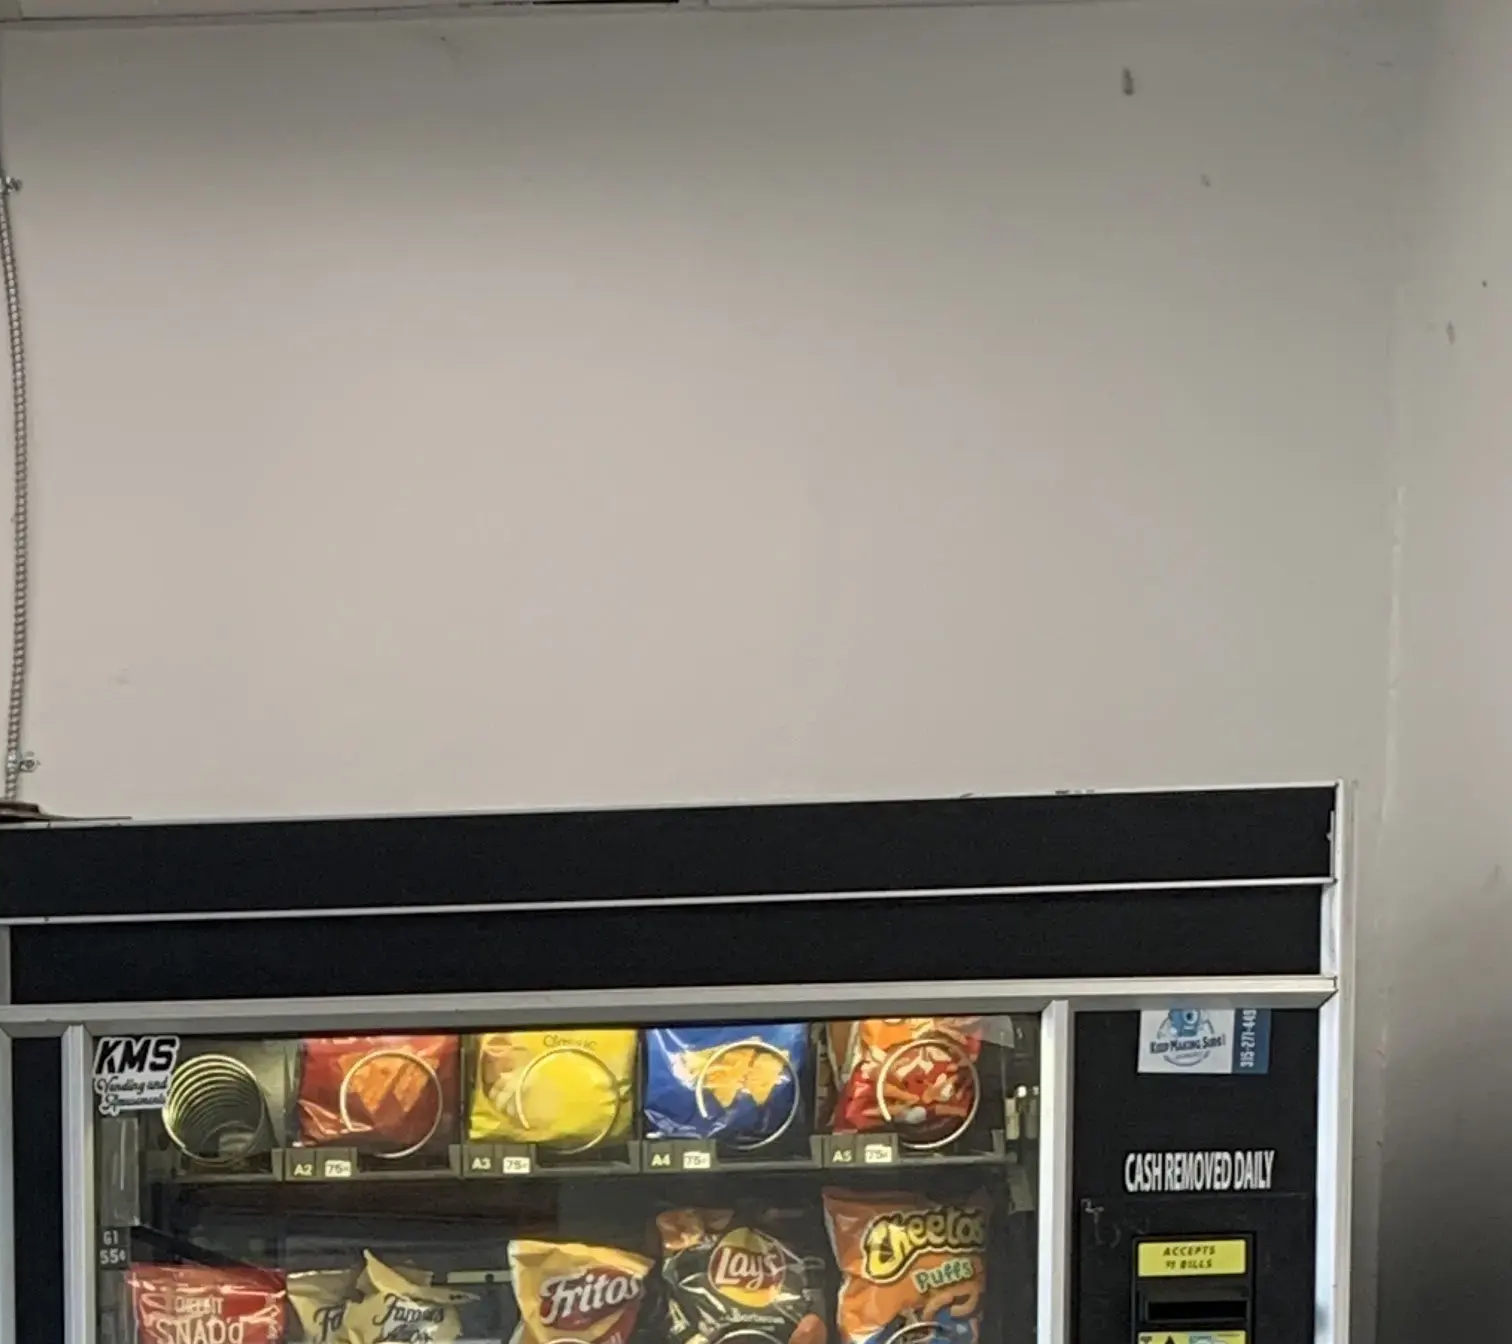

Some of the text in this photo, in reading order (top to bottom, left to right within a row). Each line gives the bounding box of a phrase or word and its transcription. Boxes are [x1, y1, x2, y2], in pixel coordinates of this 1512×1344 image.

[95, 1039, 176, 1074] KMS
[97, 1076, 145, 1095] Vending
[651, 1154, 670, 1166] A4
[833, 1150, 852, 1162] A5
[294, 1164, 312, 1176] A2
[472, 1157, 491, 1170] A3
[1125, 1150, 1275, 1192] CASH REMOVED DAILY
[104, 1231, 118, 1245] G1
[865, 1206, 985, 1280] Cheetos
[100, 1250, 126, 1264] 55¢
[1163, 1246, 1216, 1256] ACCEPTS
[1179, 1259, 1212, 1269] BILLS
[914, 1258, 973, 1293] Puffs
[540, 1272, 641, 1326] Fritos
[372, 1293, 444, 1326] Famous
